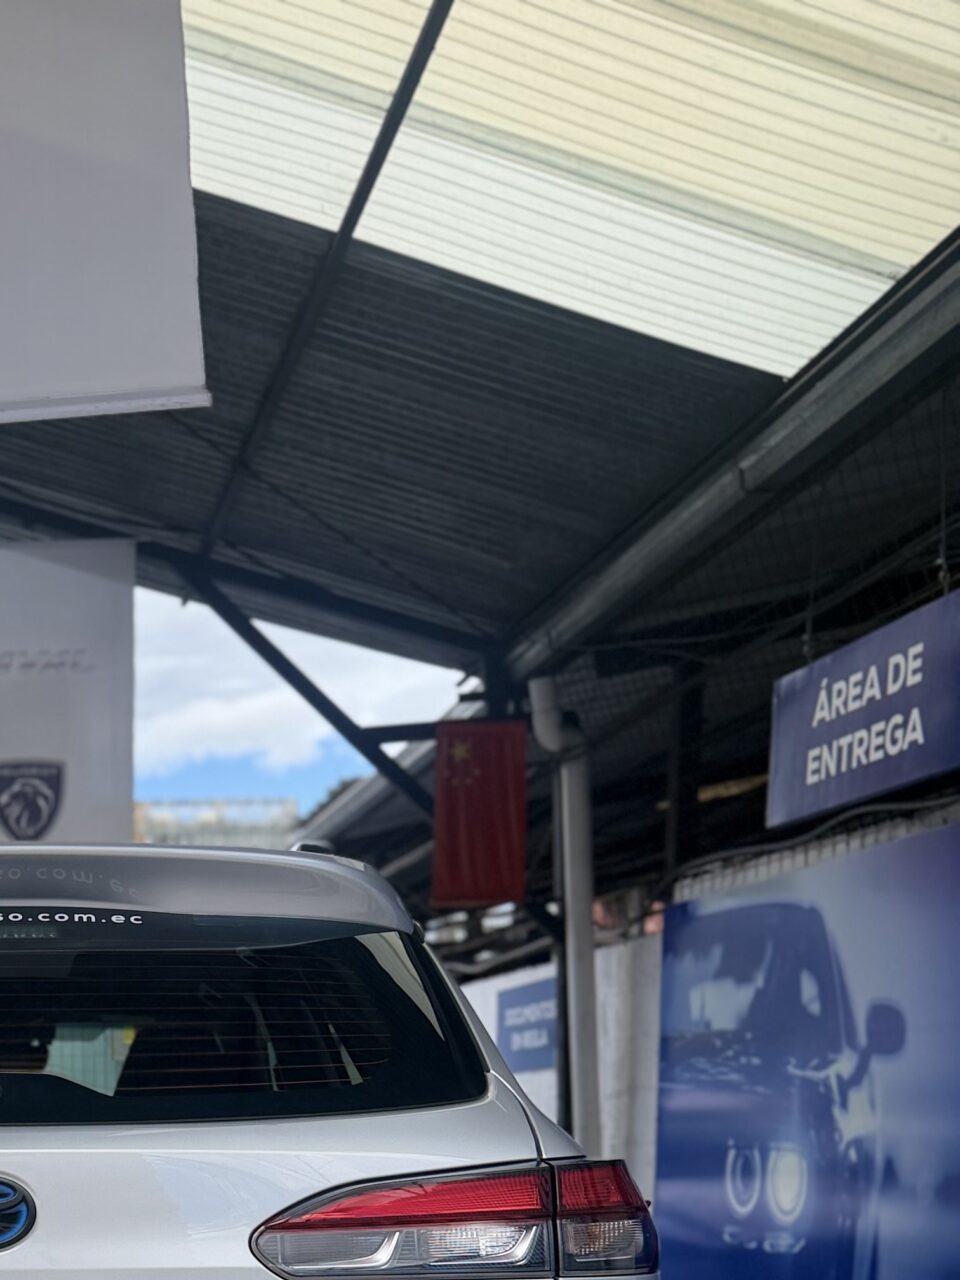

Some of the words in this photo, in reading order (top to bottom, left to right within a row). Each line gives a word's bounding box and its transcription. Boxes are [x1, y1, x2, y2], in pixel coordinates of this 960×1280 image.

[812, 664, 882, 728] ÁREA
[887, 642, 924, 695] DE
[805, 705, 925, 786] ENTREGA
